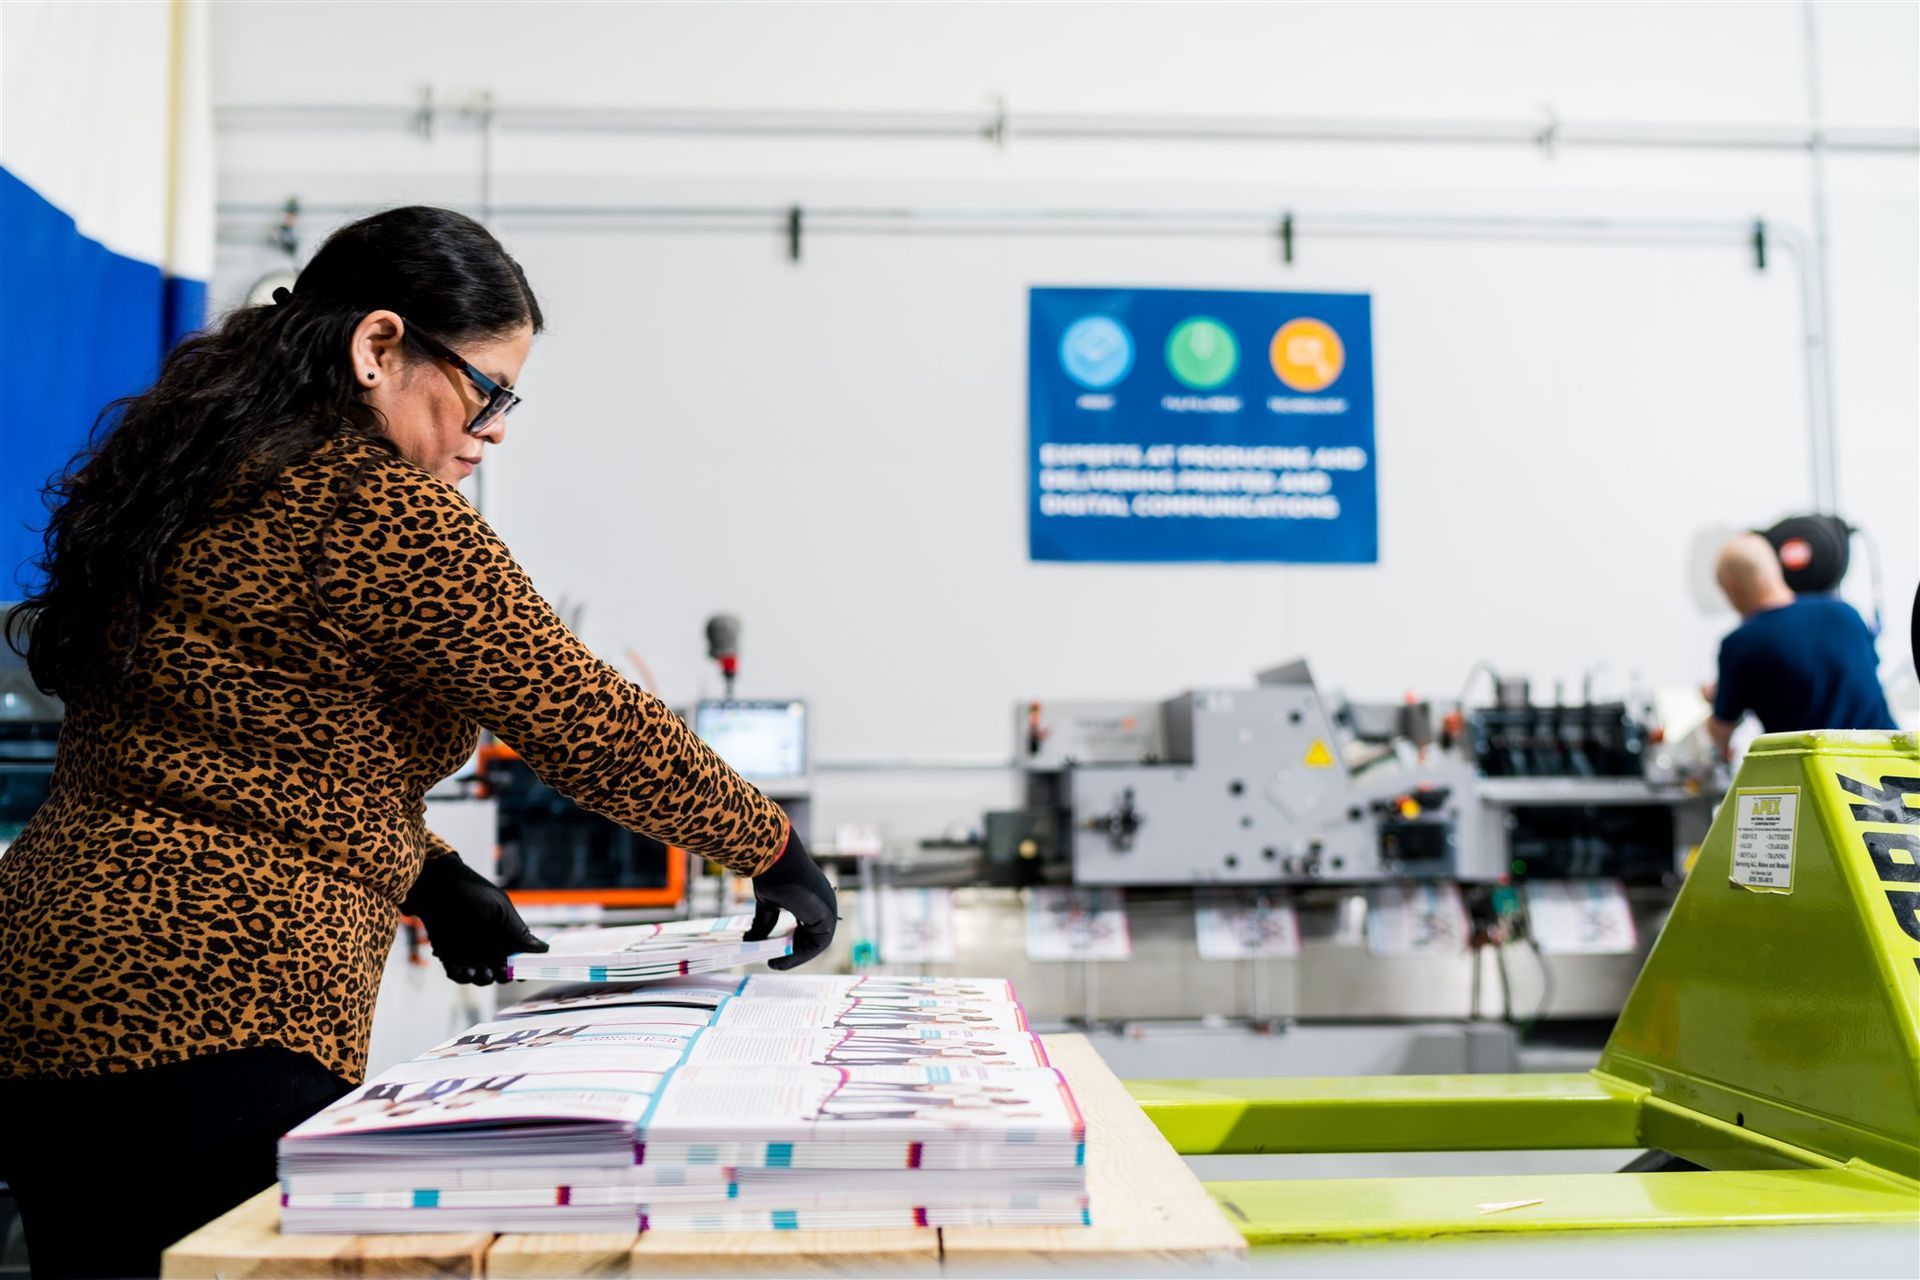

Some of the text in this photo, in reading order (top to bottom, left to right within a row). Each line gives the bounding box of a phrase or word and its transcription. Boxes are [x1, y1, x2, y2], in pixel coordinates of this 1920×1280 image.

[1040, 443, 1367, 471] EXPERTS AT PRODUCING AND
[1277, 471, 1332, 494] AND
[1040, 493, 1340, 519] DIGITAL COMMUNICATIONS
[1751, 799, 1780, 815] APEX
